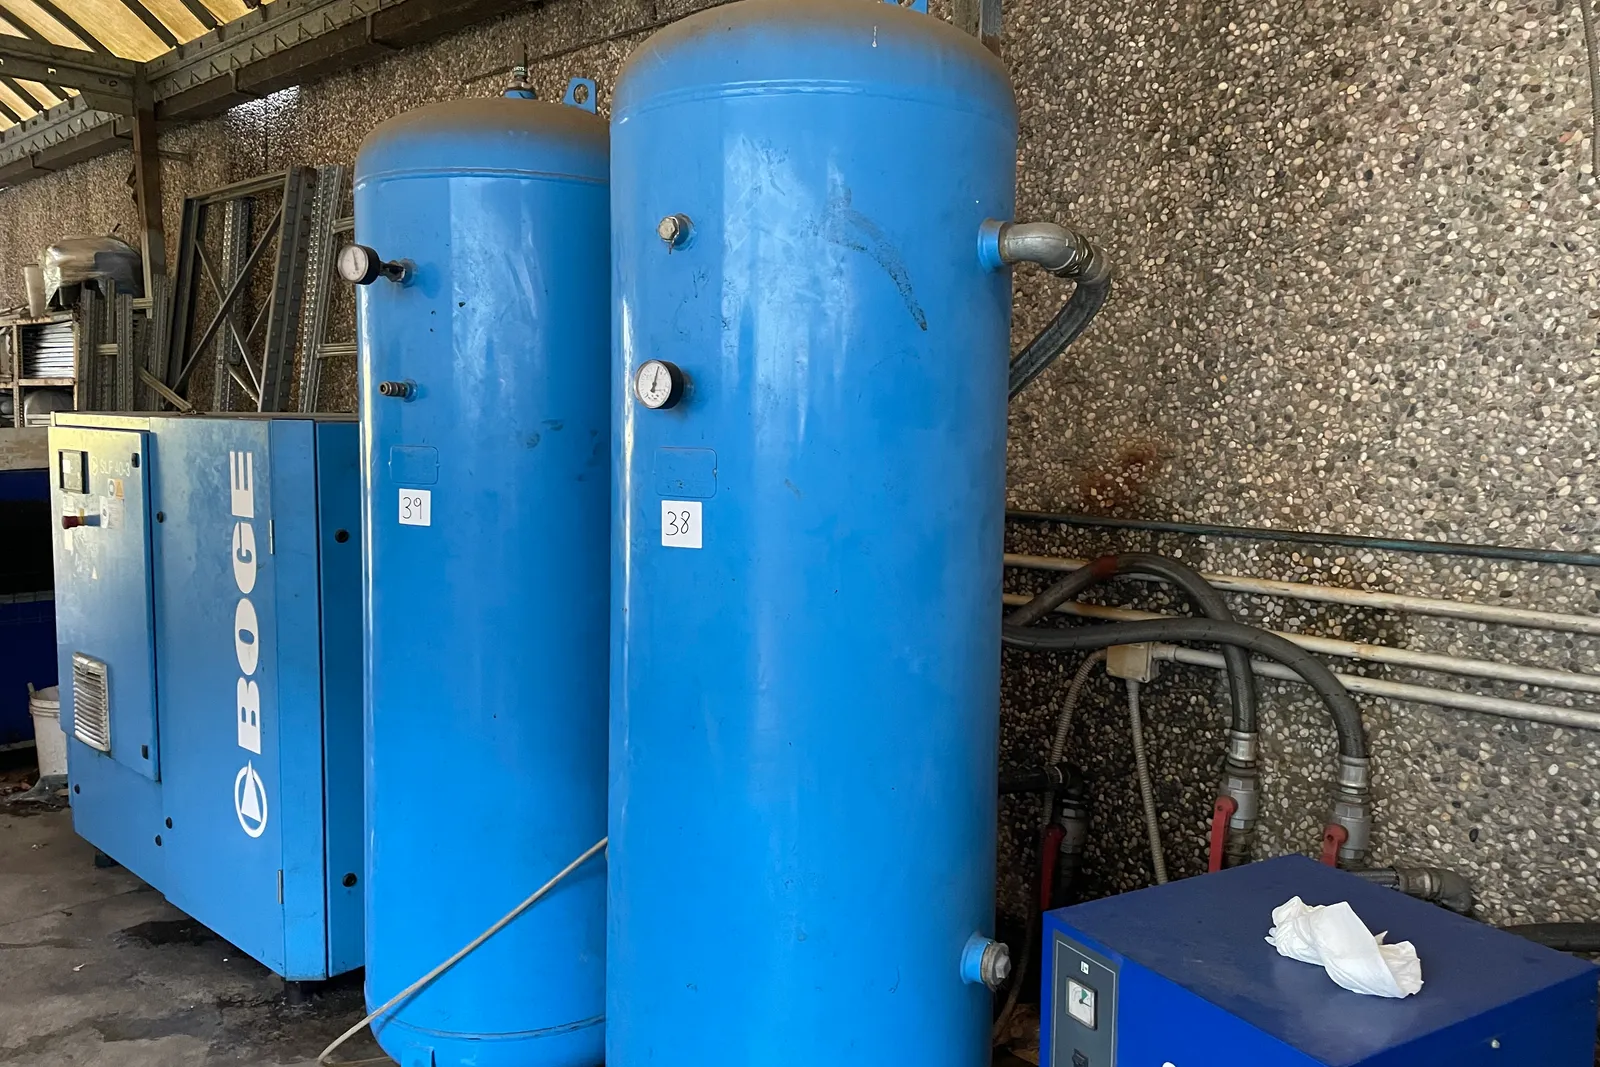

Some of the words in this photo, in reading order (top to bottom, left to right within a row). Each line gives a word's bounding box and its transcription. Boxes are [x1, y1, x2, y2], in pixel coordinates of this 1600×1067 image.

[402, 496, 422, 520] 39
[665, 510, 691, 536] 38
[229, 451, 262, 755] BOGE
